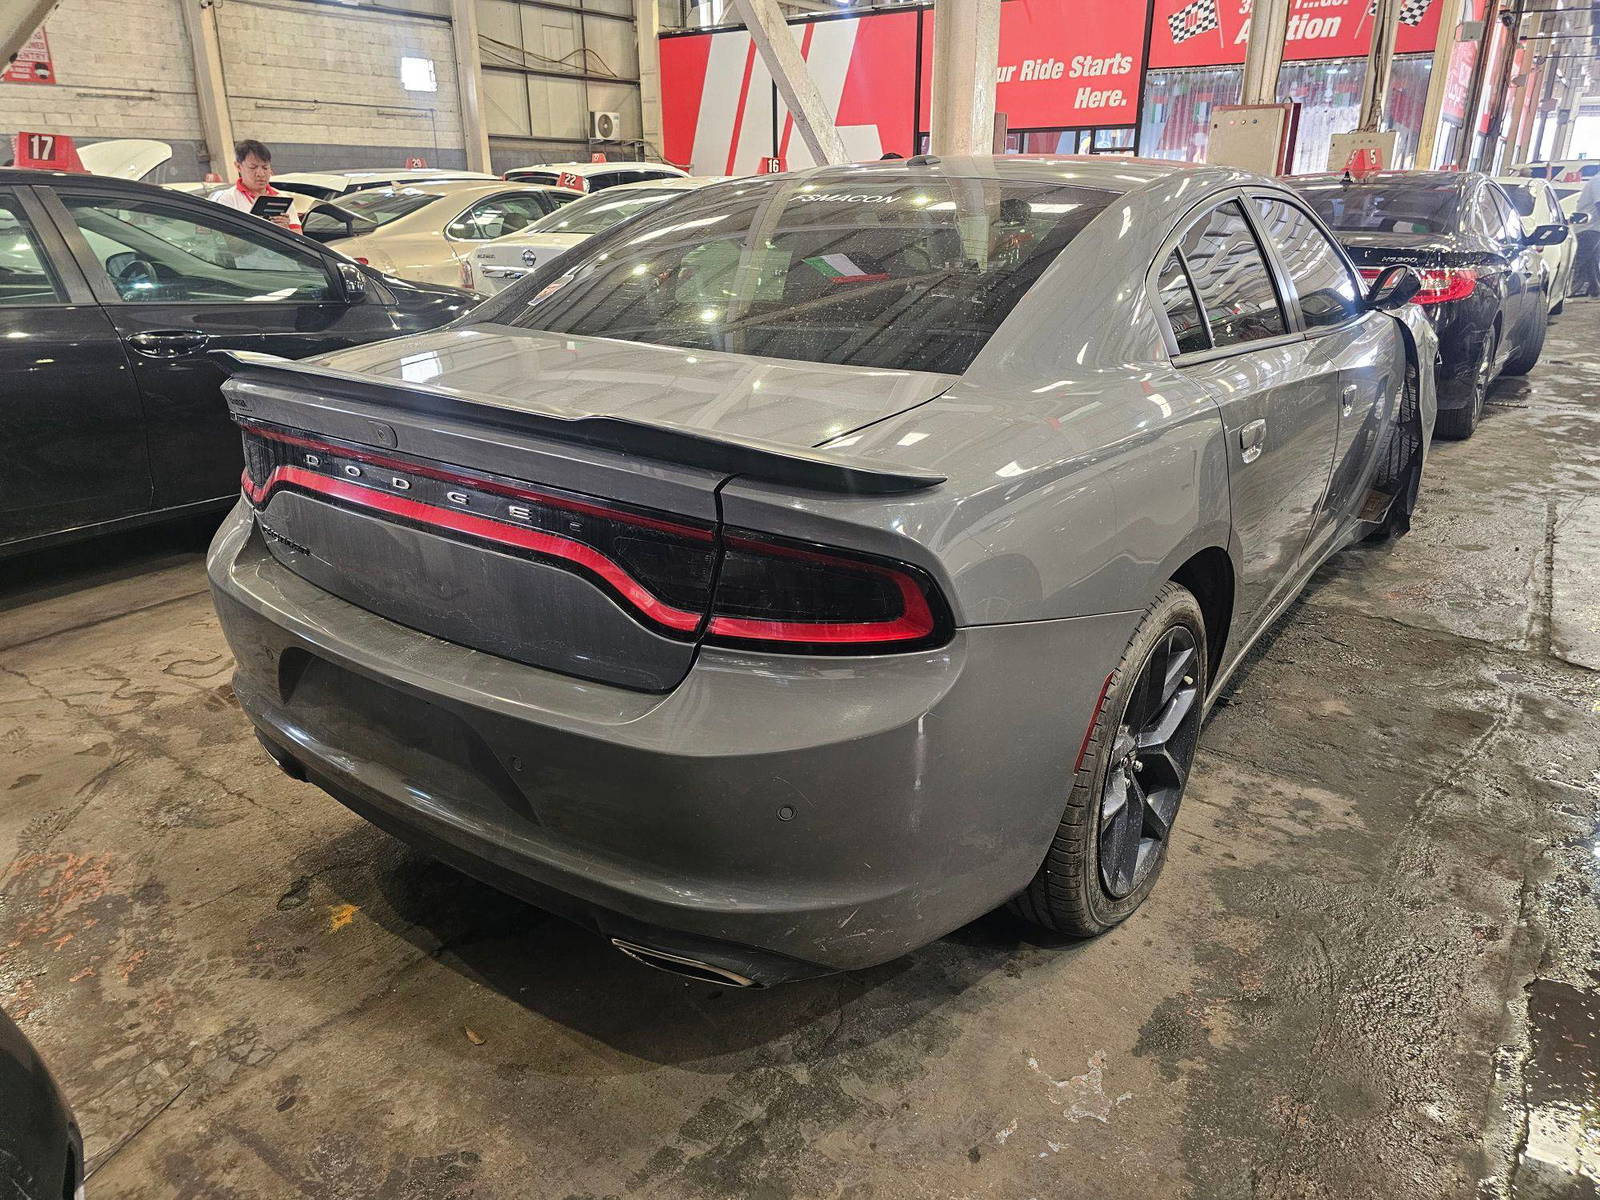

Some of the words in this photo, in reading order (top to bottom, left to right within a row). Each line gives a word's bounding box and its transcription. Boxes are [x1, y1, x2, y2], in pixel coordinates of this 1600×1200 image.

[1233, 14, 1342, 45] Ation
[1019, 58, 1065, 82] Ride
[1068, 53, 1133, 78] Starts
[1073, 87, 1128, 110] Here.
[30, 135, 54, 160] 17
[1370, 149, 1376, 165] 5
[767, 158, 780, 173] 16
[564, 173, 577, 186] 22
[305, 453, 532, 521] DODGE
